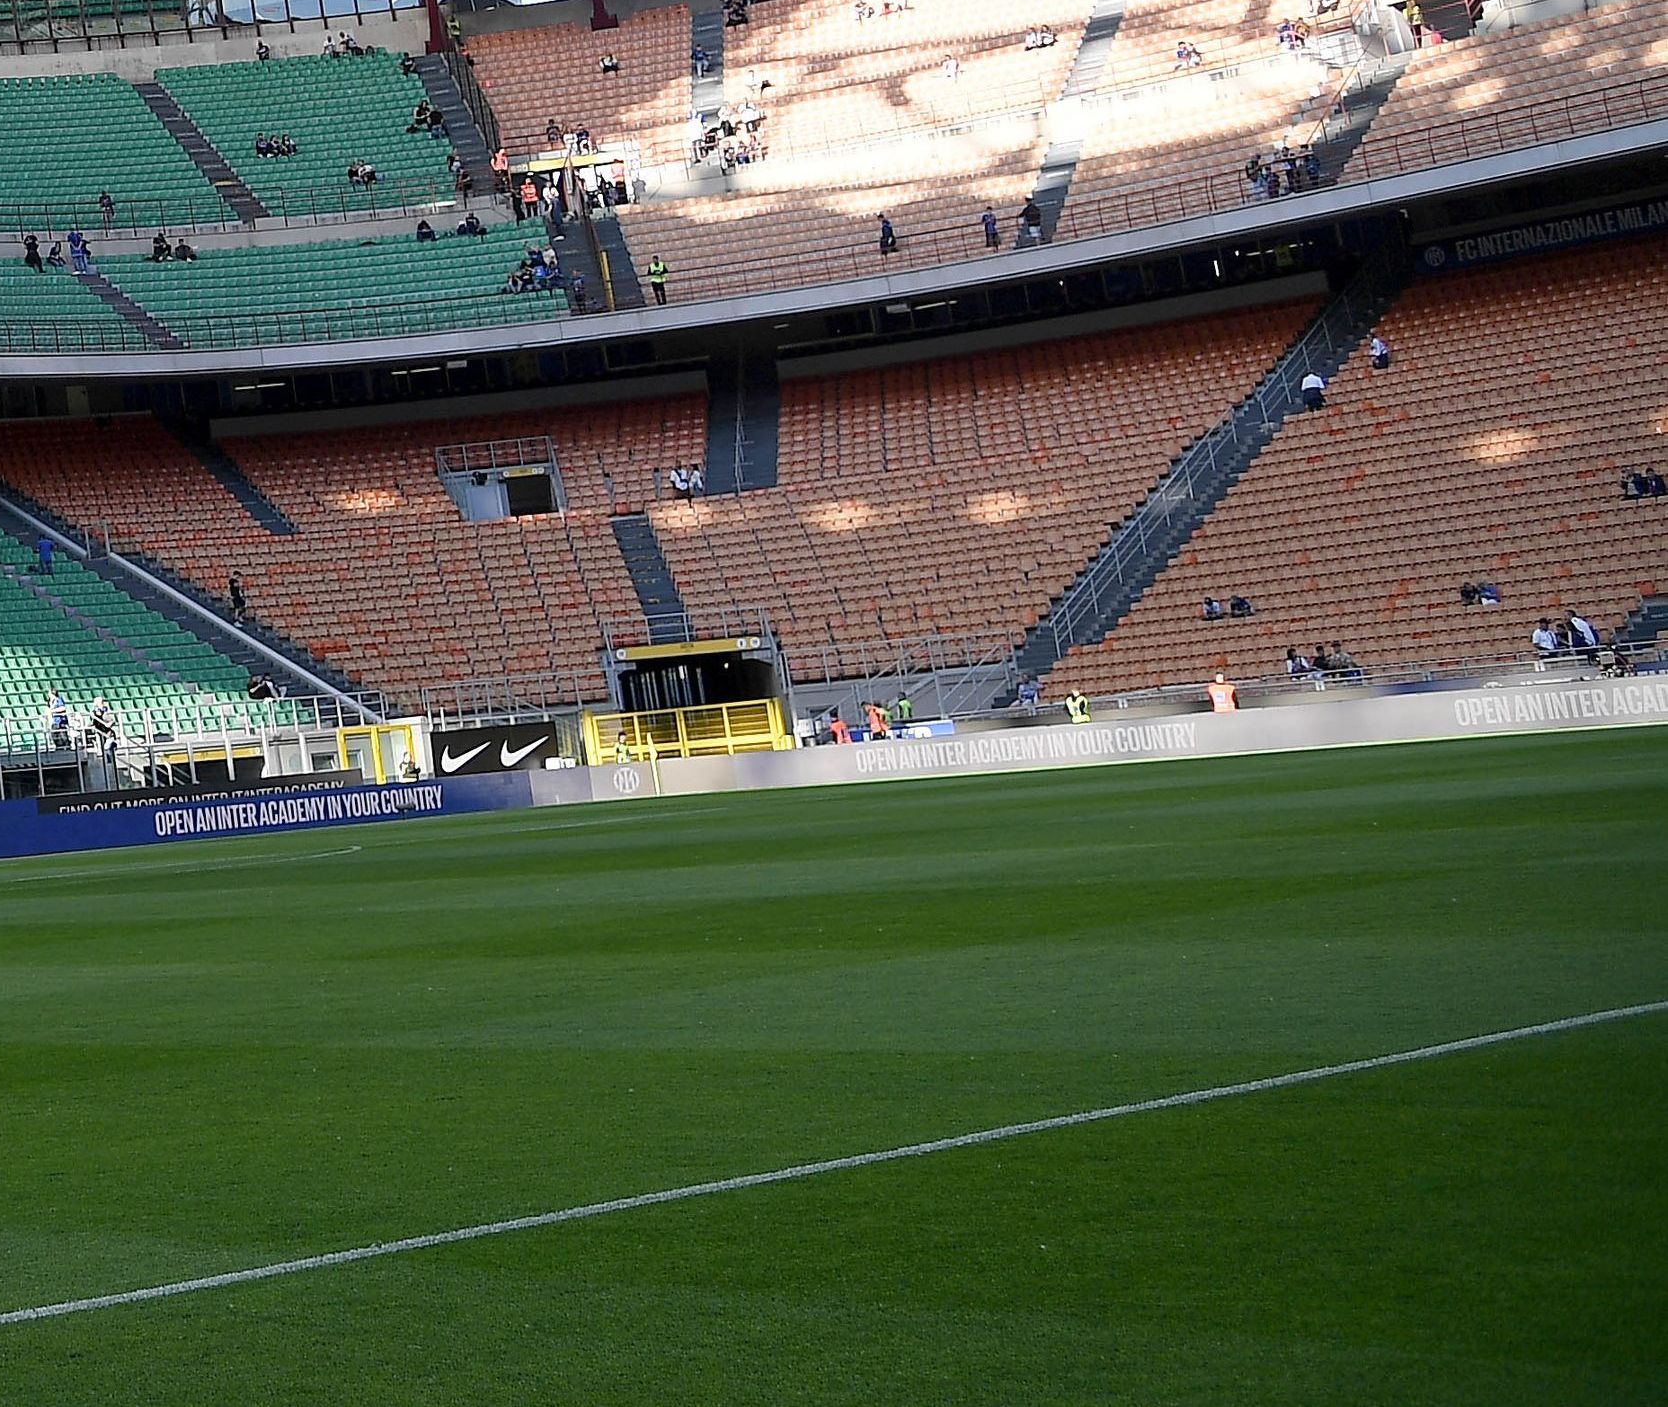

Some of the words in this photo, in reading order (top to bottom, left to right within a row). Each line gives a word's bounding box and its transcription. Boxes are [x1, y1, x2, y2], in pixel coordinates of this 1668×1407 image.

[1456, 240, 1477, 261] FC
[1478, 210, 1616, 256] INTERNAZIONALE
[1454, 695, 1512, 726] OPEN
[1514, 693, 1546, 722] AN
[1547, 688, 1610, 719] INTER
[855, 747, 898, 773] OPEN
[899, 745, 922, 770] AN
[923, 742, 965, 768] INTER
[970, 734, 1047, 764] ACADEMY
[1049, 733, 1066, 759] IN
[1068, 728, 1114, 756] YOUR
[1115, 723, 1197, 753] COUNTRY
[154, 809, 195, 836] OPEN
[196, 807, 216, 833] AN
[216, 802, 258, 830] INTER
[259, 794, 325, 826] ACADEMY
[327, 794, 342, 819] IN
[344, 791, 381, 818] YOUR
[382, 785, 442, 814] COUNTRY
